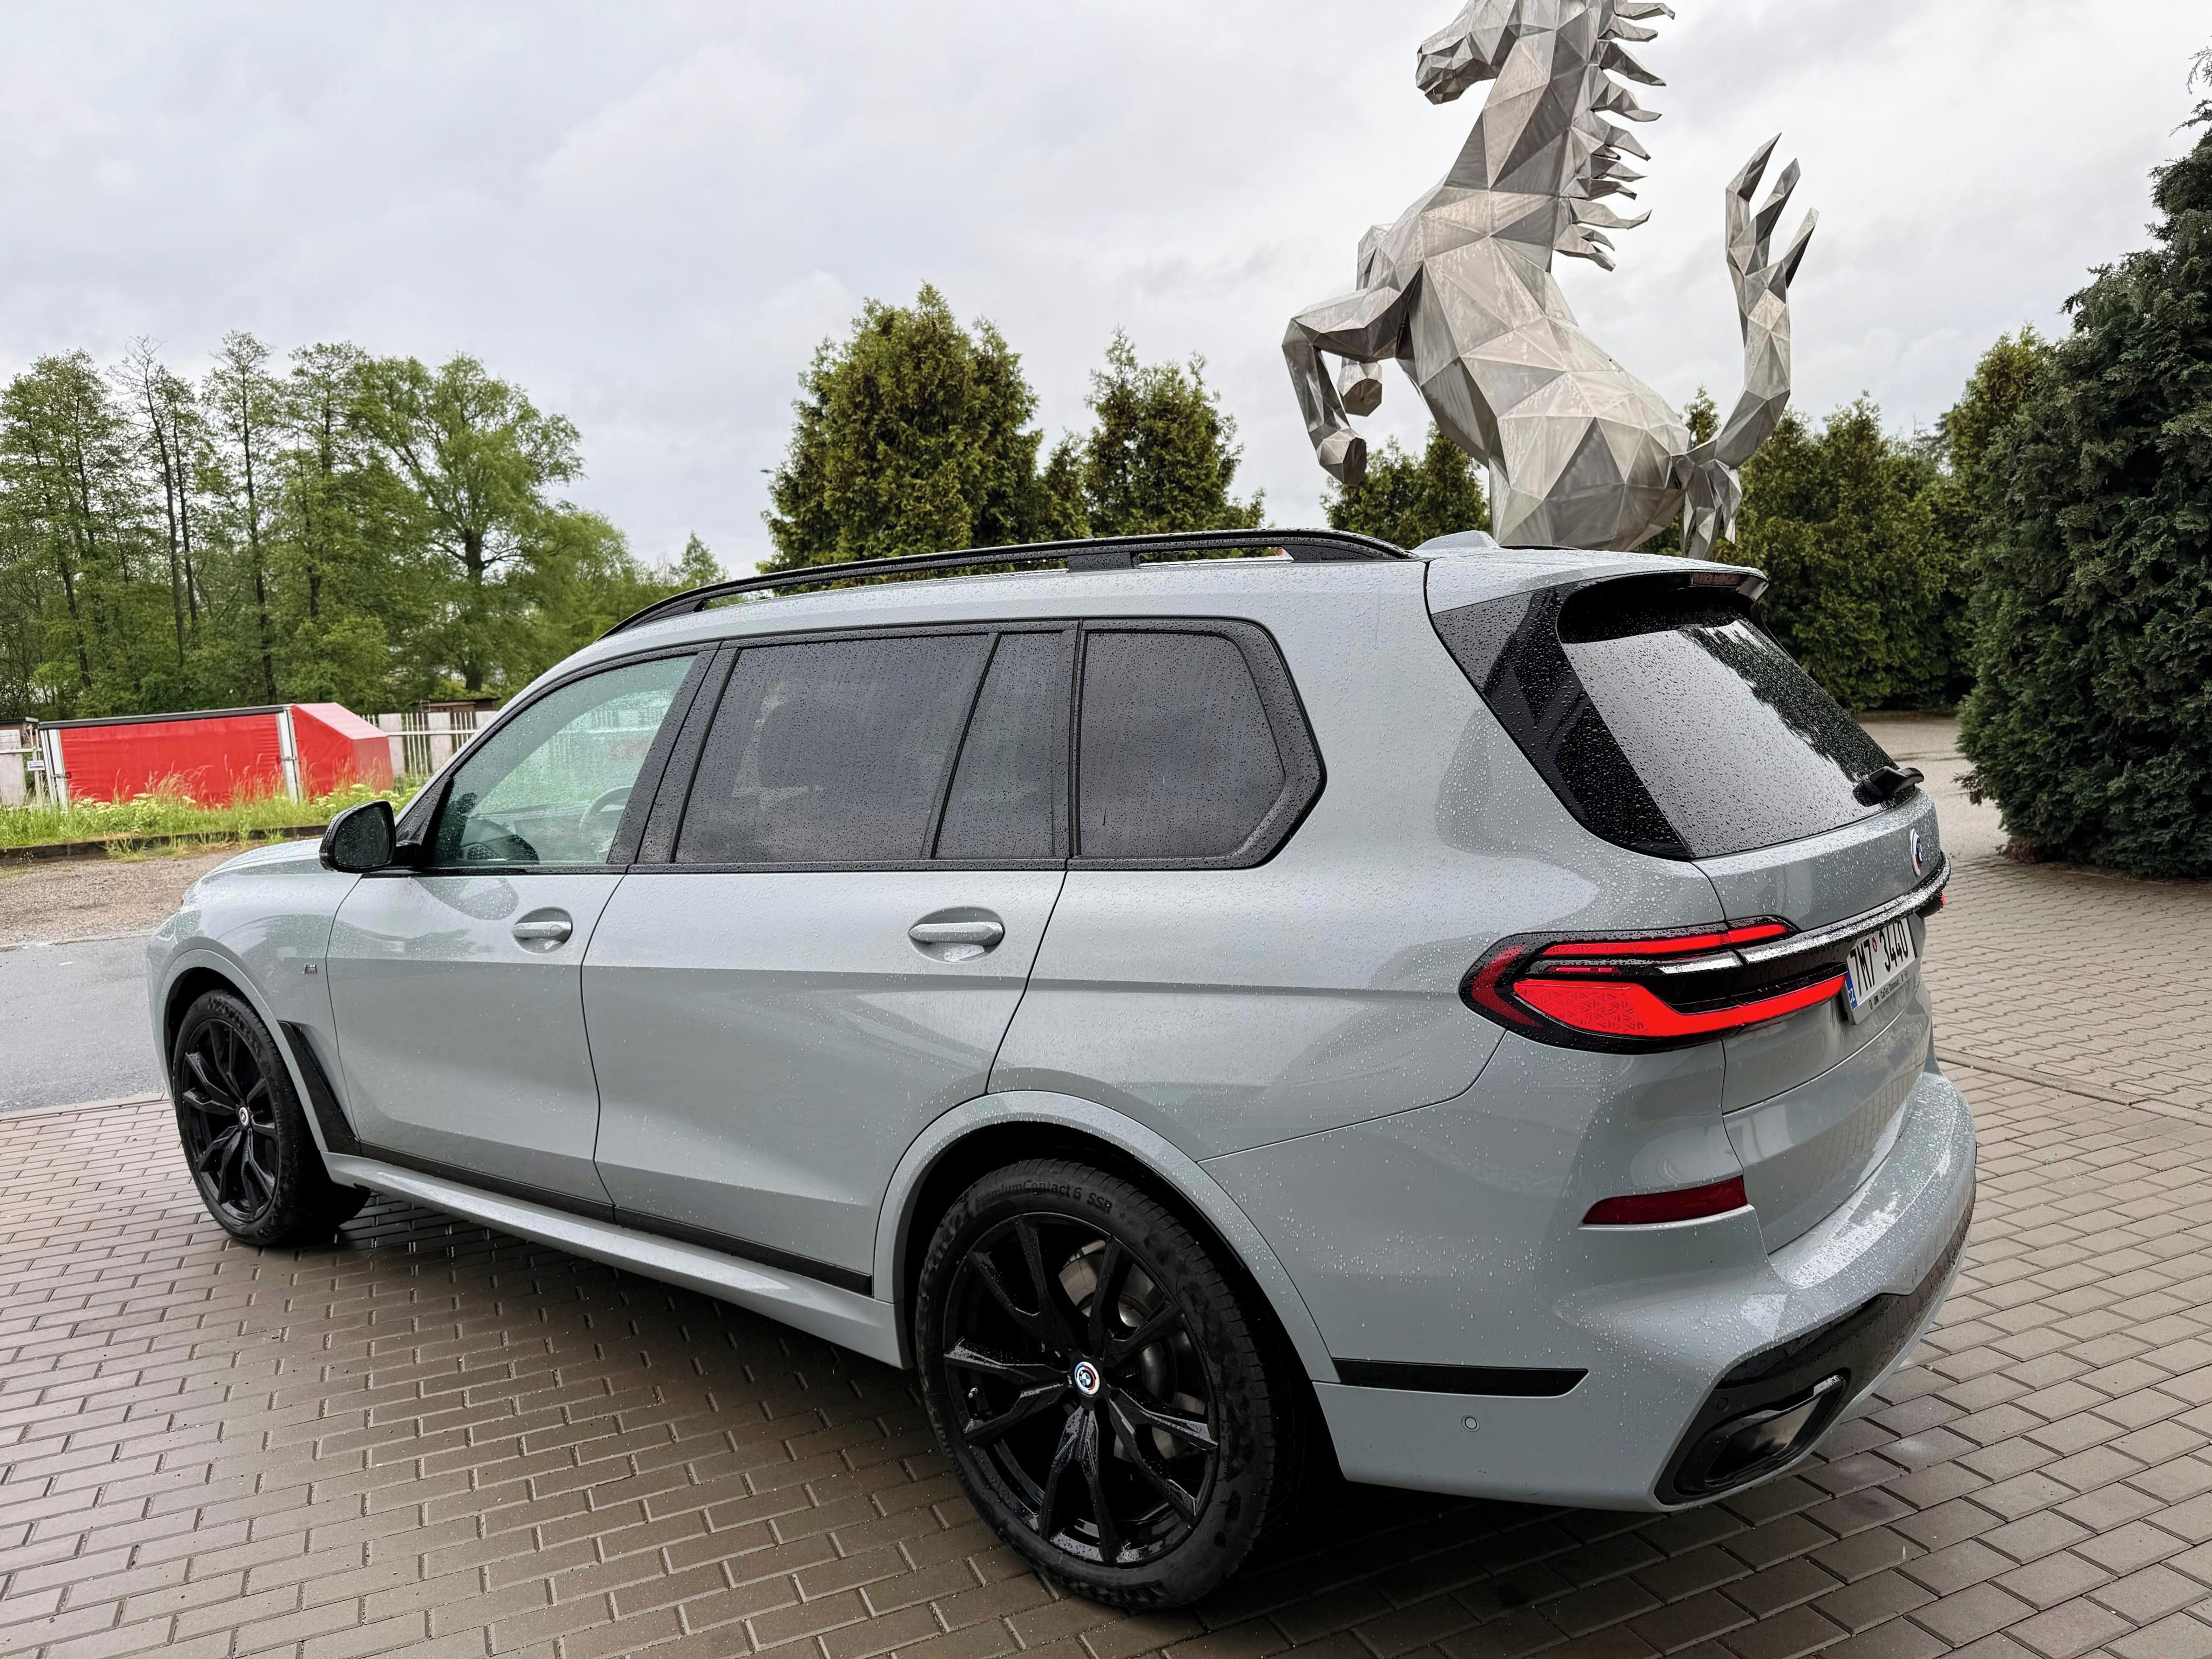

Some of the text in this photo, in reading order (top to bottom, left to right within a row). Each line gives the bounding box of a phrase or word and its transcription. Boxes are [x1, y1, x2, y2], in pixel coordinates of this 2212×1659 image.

[1850, 920, 1908, 997] 7M7 3440
[1849, 988, 1856, 1003] CZ
[1086, 1192, 1114, 1215] SSR
